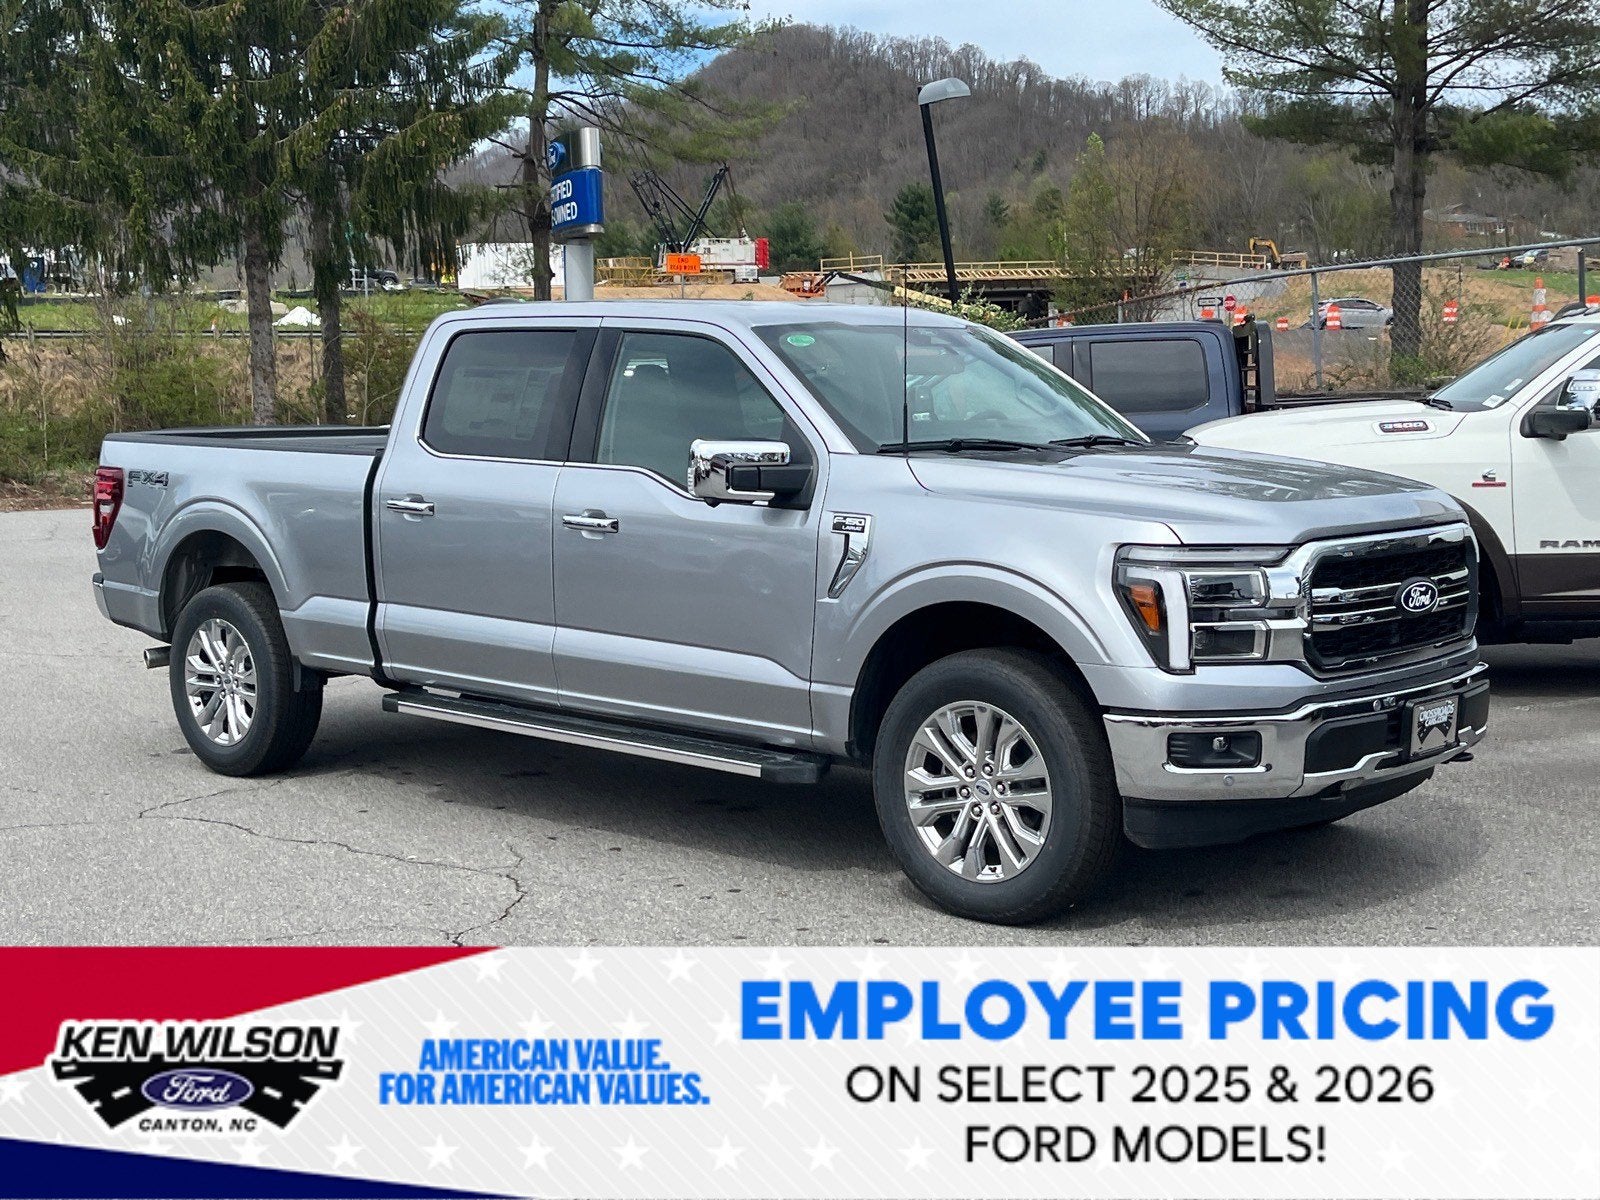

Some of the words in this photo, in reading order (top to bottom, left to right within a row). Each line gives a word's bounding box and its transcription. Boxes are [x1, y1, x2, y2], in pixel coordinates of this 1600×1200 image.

[127, 470, 169, 488] FX4
[833, 516, 865, 526] F-150
[1539, 540, 1600, 549] RAM
[1408, 586, 1431, 608] Ford
